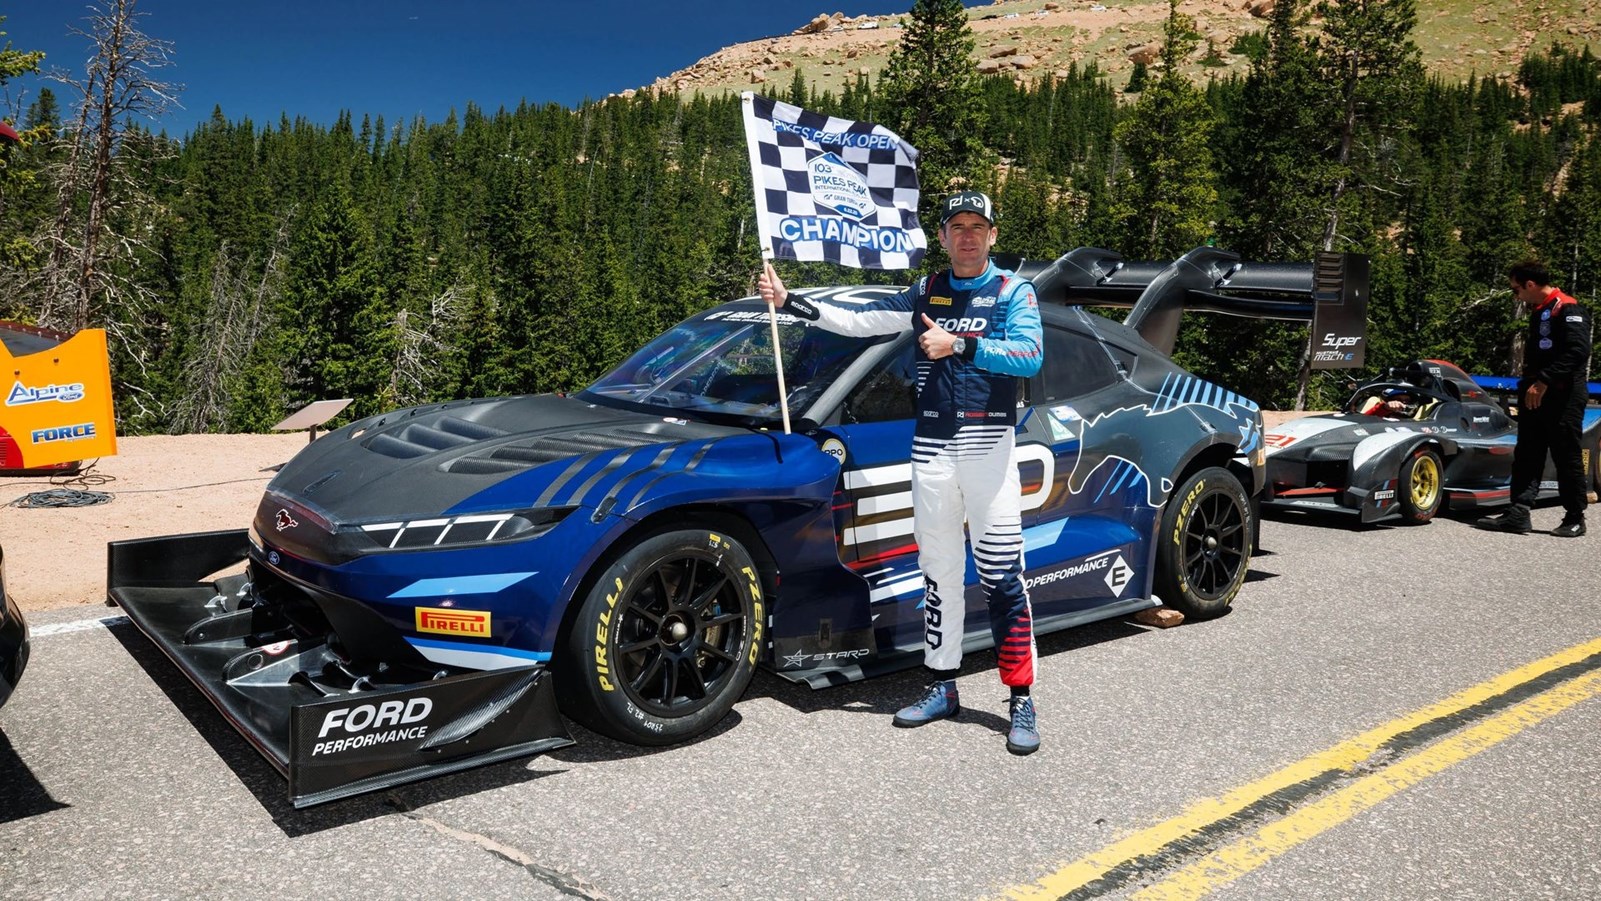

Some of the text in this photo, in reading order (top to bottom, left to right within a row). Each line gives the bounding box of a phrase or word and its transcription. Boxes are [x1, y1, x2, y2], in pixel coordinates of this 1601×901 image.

[772, 119, 897, 149] PIKES PEAK OPEN
[814, 163, 832, 173] 103
[813, 175, 846, 187] PIKES
[847, 180, 867, 196] PEAK
[780, 218, 916, 252] CHAMPION
[935, 317, 987, 332] FORD
[1322, 333, 1362, 350] Super
[7, 383, 83, 404] Alpine
[32, 424, 96, 443] FORCE
[1033, 557, 1109, 588] PERFORMANCE
[1111, 565, 1126, 587] E
[421, 611, 485, 633] PIRELLI
[924, 574, 943, 650] FORD
[595, 577, 624, 692] PIRELLI
[812, 648, 870, 661] STARD
[318, 697, 433, 738] FORD
[312, 726, 428, 756] PERFORMANCE
